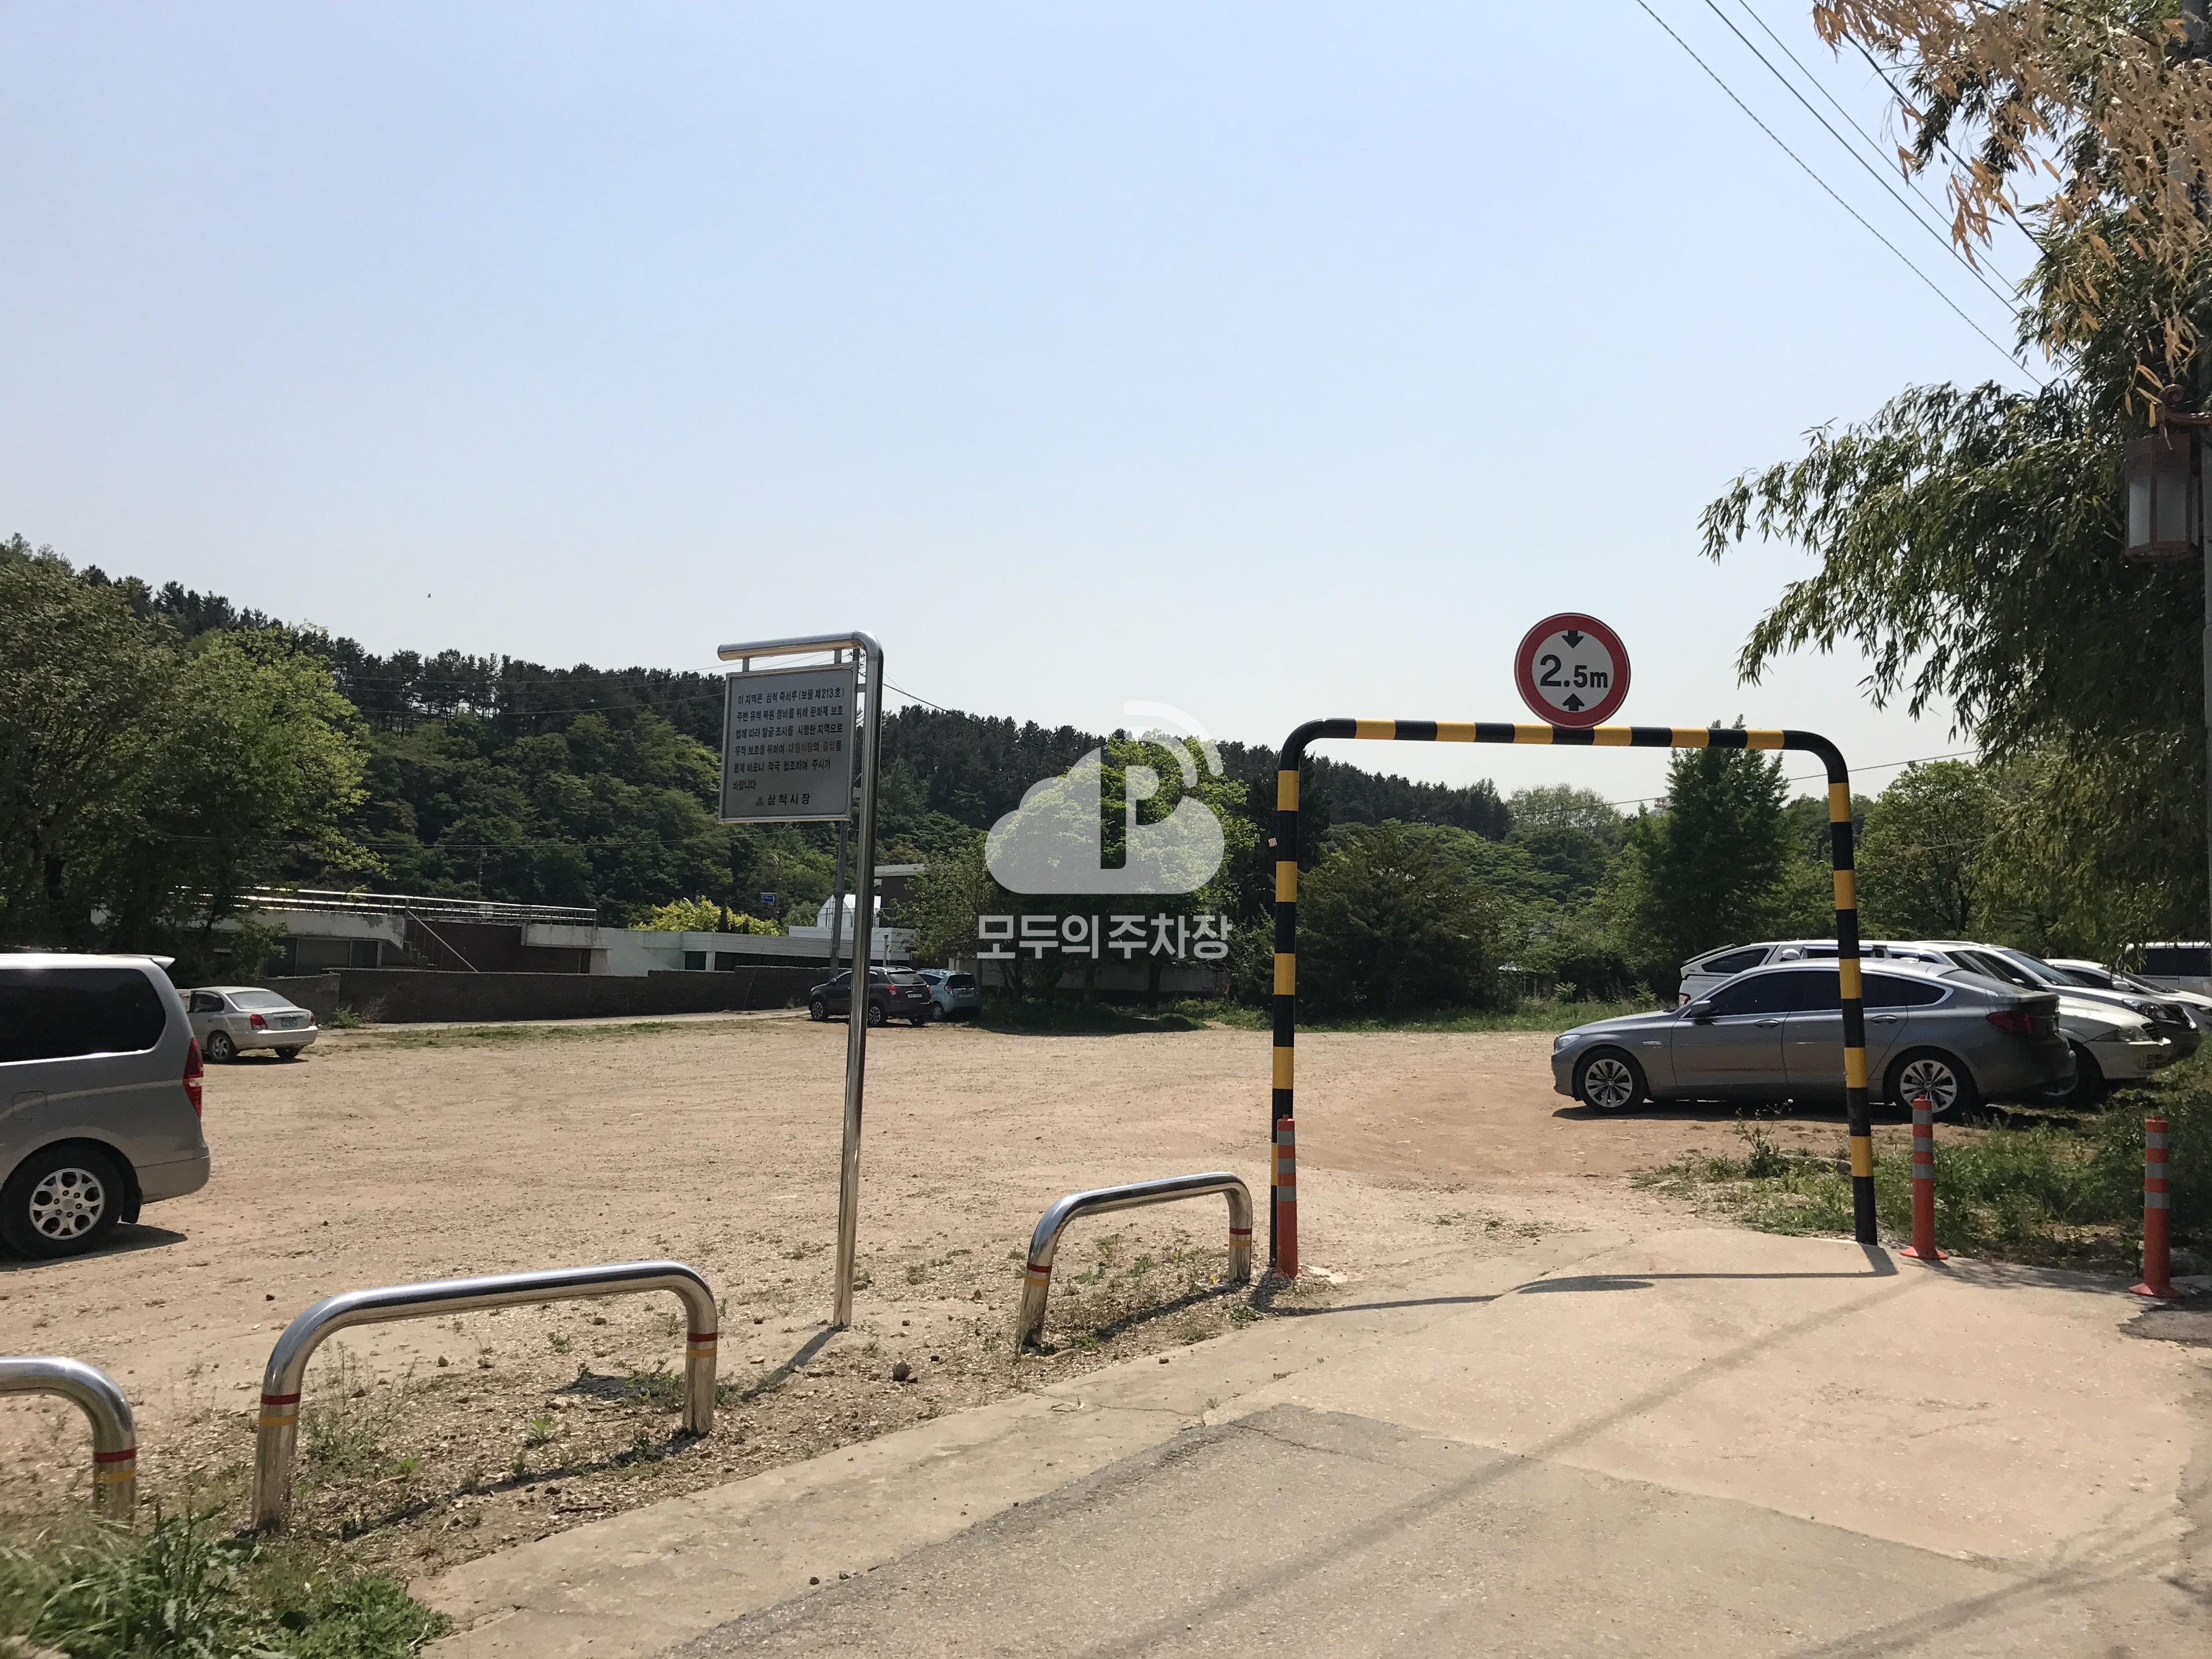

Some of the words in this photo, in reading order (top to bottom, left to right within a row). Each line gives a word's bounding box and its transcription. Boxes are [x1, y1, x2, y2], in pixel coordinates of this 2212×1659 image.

[1539, 654, 1608, 688] 2.5m
[738, 695, 743, 704] 이
[745, 693, 763, 704] 지역은
[766, 692, 778, 703] 삼척
[737, 711, 748, 722] 주변
[750, 711, 761, 721] 유적
[763, 710, 775, 720] 복원
[777, 708, 794, 720] 정비를
[797, 707, 808, 718] 위해
[810, 706, 828, 718] 문화재
[831, 705, 843, 715] 보호
[736, 729, 747, 739] 법에
[749, 727, 760, 738] 따라
[763, 727, 774, 737] 발굴
[775, 725, 794, 736] 조사를
[798, 724, 816, 735] 시행한
[817, 723, 843, 734] 지역으로
[735, 746, 746, 756] 유적
[748, 744, 765, 755] 보호를
[767, 743, 785, 754] 위하여
[768, 761, 780, 771] 적극
[783, 760, 808, 771] 협조하여
[812, 759, 831, 770] 주시기
[733, 780, 756, 791] 바랍니다
